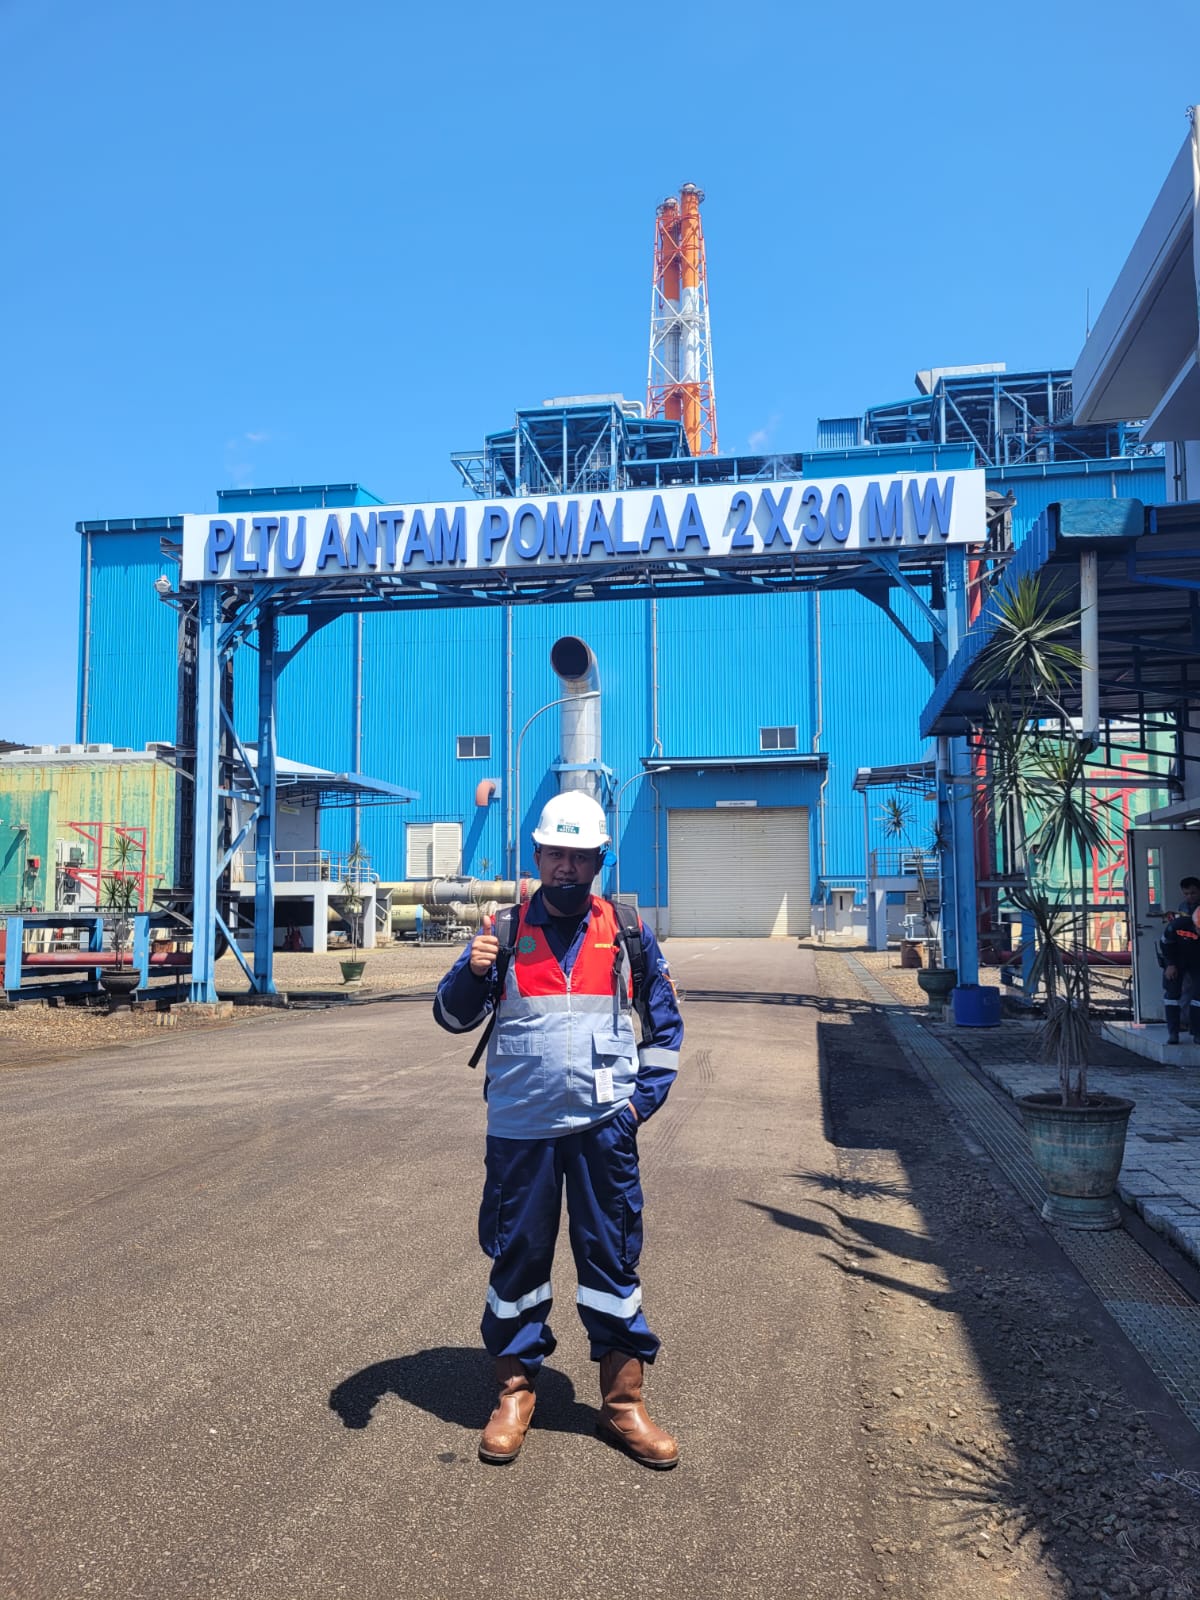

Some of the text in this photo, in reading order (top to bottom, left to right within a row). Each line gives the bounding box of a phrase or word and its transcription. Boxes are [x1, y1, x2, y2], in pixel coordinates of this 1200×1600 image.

[210, 477, 955, 574] PLTU ANTAM POMALAA 2X30 MW
